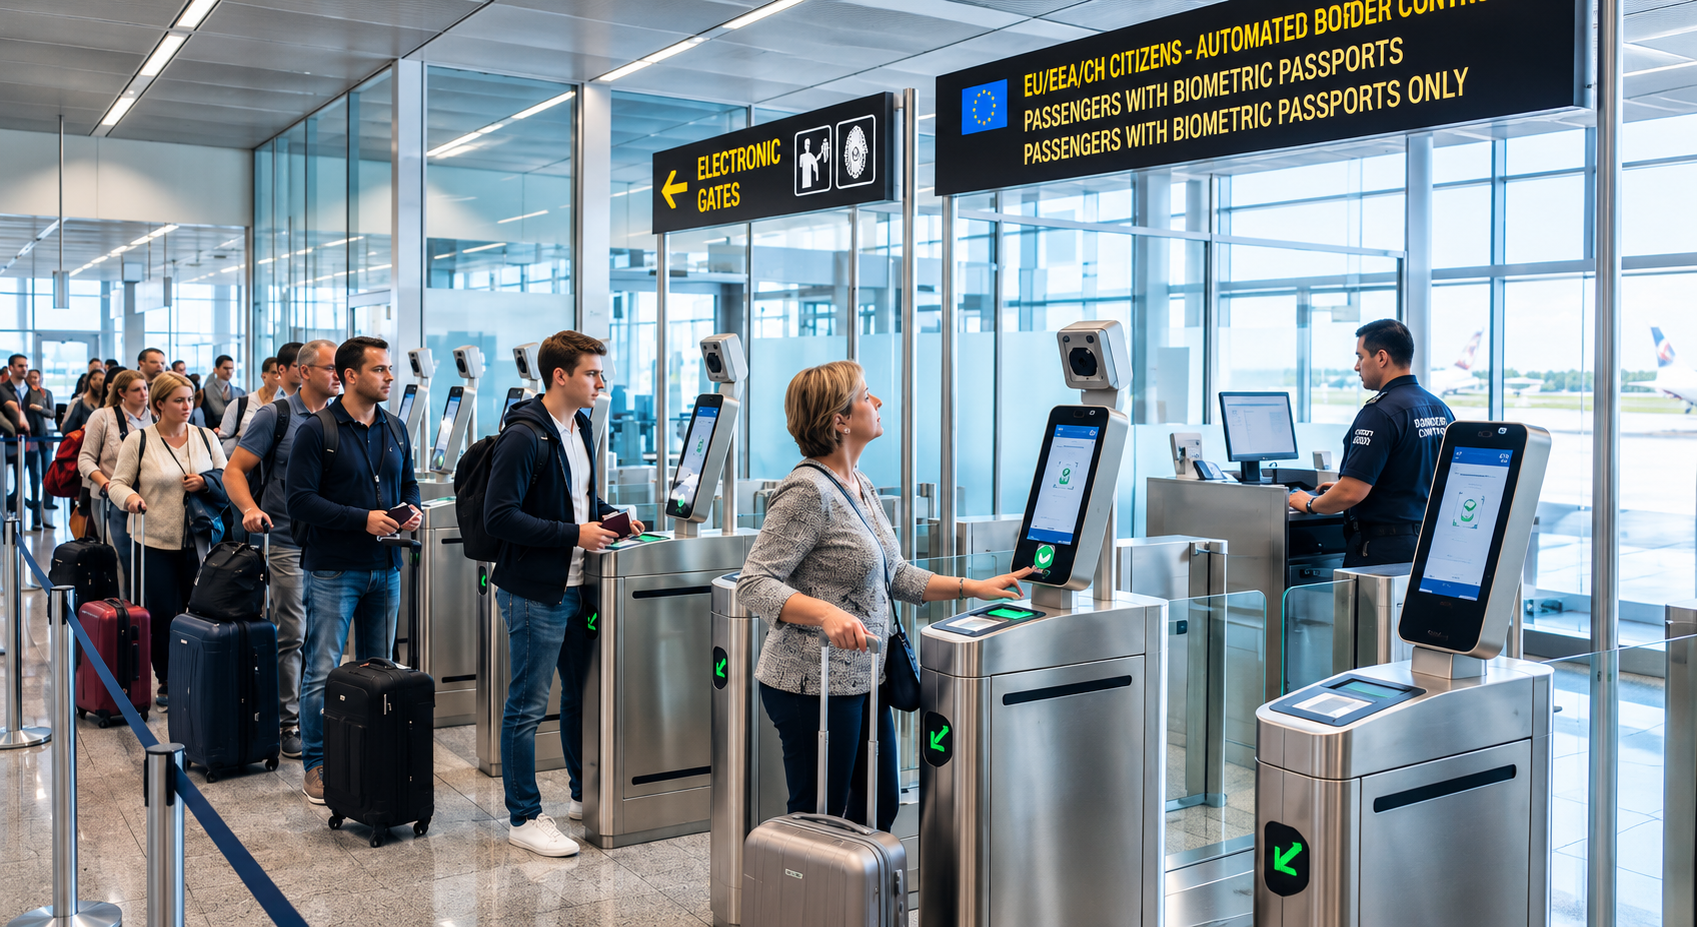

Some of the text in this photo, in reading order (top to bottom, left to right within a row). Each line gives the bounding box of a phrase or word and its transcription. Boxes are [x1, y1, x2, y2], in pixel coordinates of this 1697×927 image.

[1025, 57, 1106, 98] EU/EEA/CH
[1110, 39, 1183, 78] CITIZENS
[1196, 13, 1308, 61] AUTOMATED
[1025, 37, 1404, 132] PASSENGERS WITH BIOMETRIC PASSPORTS
[1025, 67, 1469, 166] PASSENGERS WITH BIOMETRIC PASSPORTS ONLY
[697, 138, 781, 213] ELECTRONIC GATES
